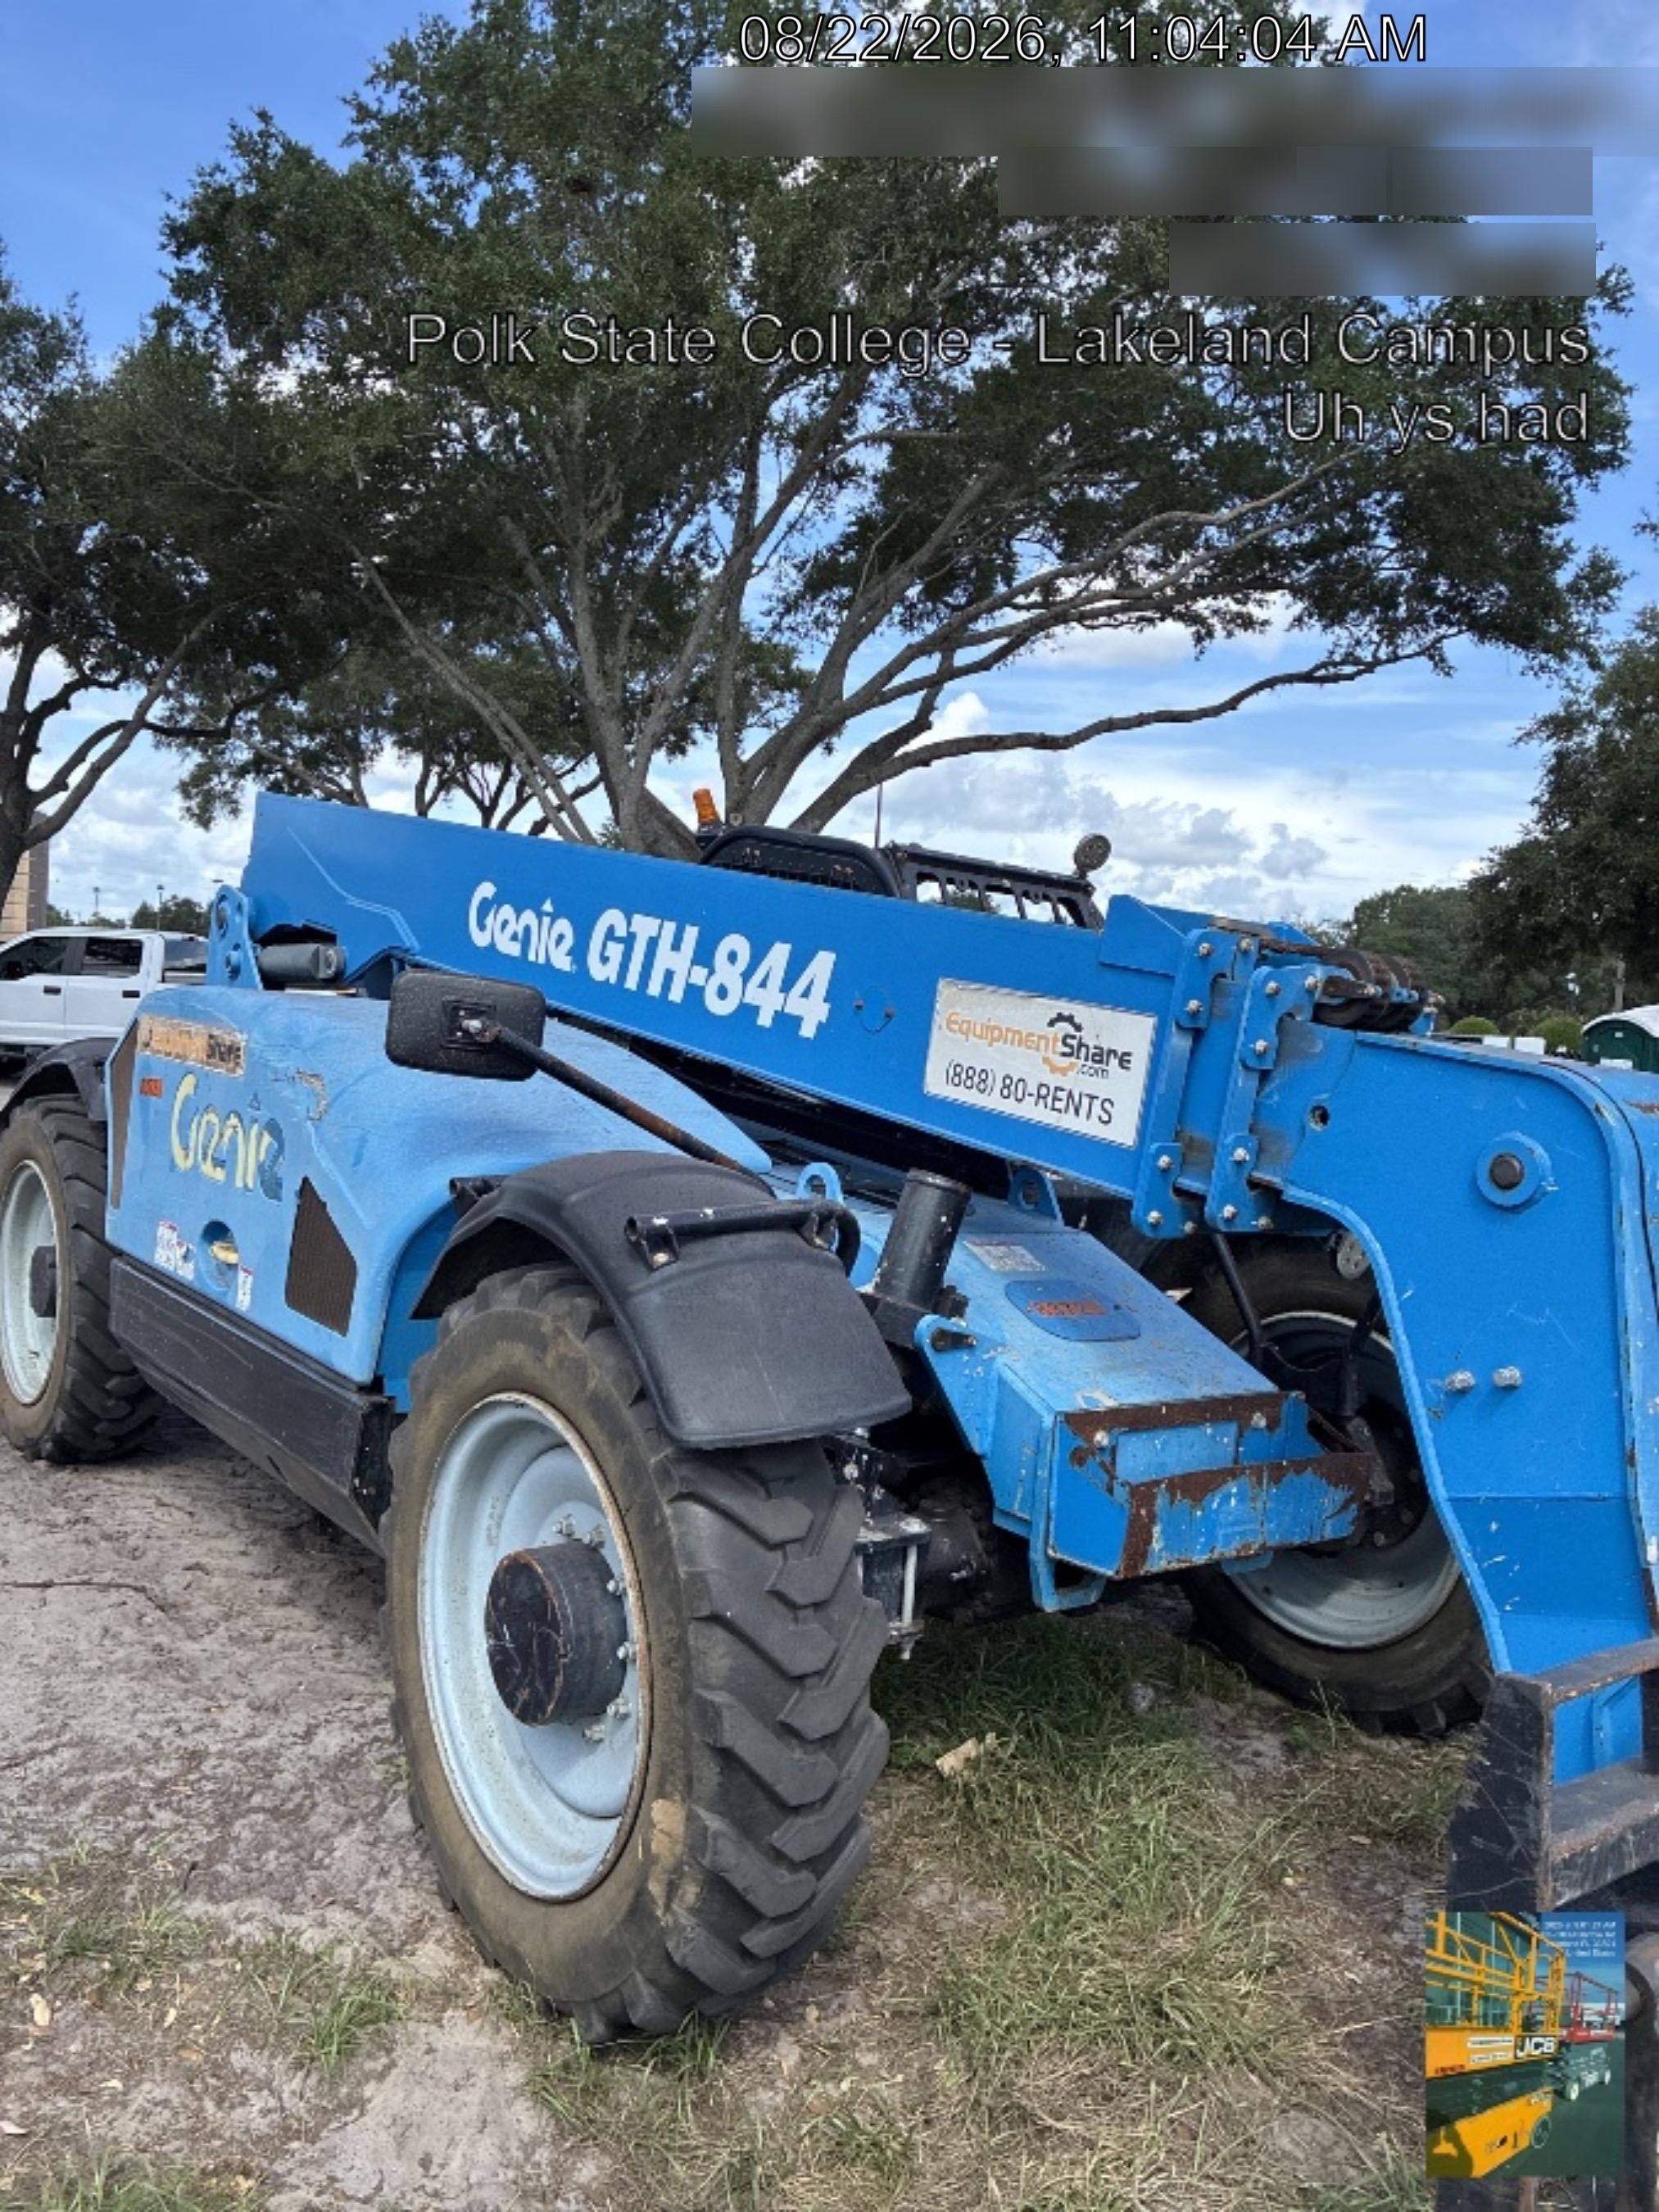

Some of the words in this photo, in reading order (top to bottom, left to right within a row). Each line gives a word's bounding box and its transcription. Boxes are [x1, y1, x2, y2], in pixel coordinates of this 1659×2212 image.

[469, 882, 574, 972] Genie
[587, 909, 836, 1040] GTH-844
[945, 1058, 996, 1096] (888)
[999, 1072, 1115, 1126] 80-RENTS
